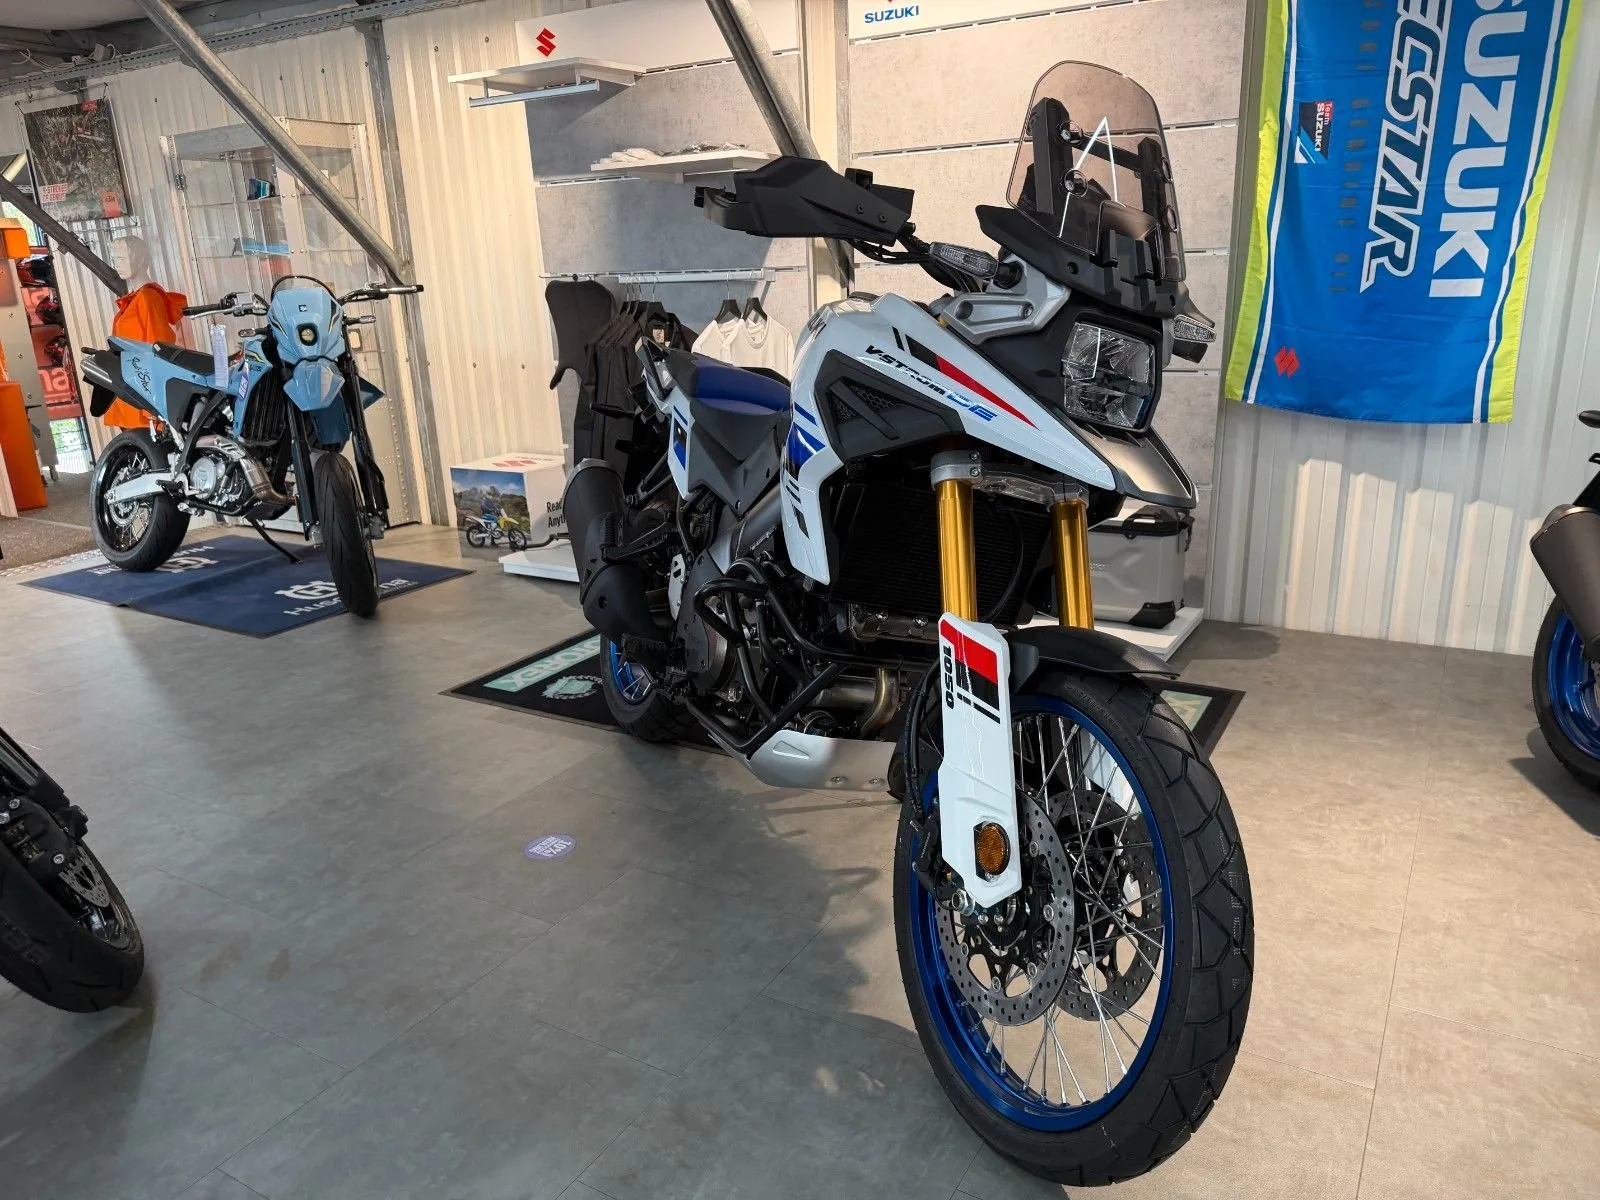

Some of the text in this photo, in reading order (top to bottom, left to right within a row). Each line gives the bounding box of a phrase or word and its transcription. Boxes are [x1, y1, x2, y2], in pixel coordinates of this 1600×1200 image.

[864, 5, 919, 23] SUZUKI
[1314, 102, 1325, 152] SUZUKI
[1323, 102, 1333, 125] Team
[1429, 0, 1528, 297] UZUKI
[943, 644, 955, 710] 1050
